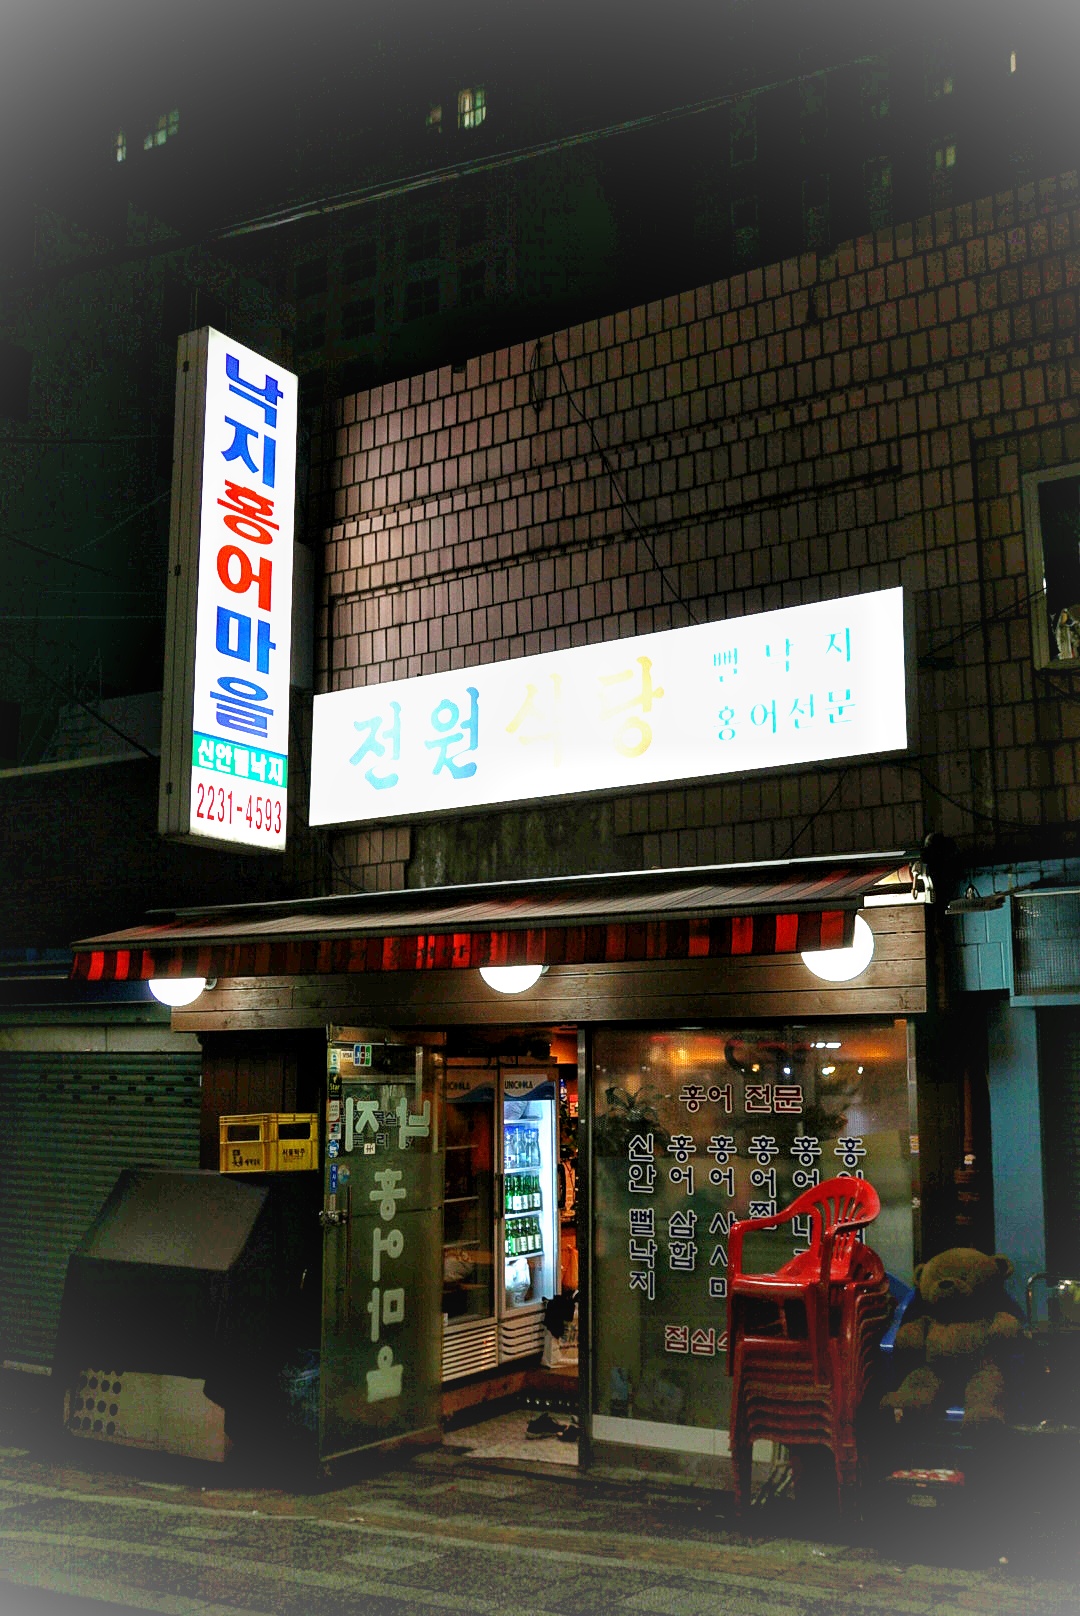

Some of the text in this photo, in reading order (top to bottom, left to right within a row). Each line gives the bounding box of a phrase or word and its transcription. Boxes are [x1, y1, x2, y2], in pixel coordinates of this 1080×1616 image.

[349, 655, 665, 791] 전원식당
[198, 739, 284, 786] 신안낙지
[197, 783, 282, 834] 2231-4593
[679, 1084, 803, 1114] 홍어 전문
[707, 1135, 737, 1197] 홍어
[749, 1135, 779, 1198] 홍어
[790, 1136, 822, 1188] 홍어
[833, 1137, 866, 1180] 홍
[628, 1133, 657, 1300] 신안 뻘낙지
[666, 1134, 698, 1270] 홍어 삼합
